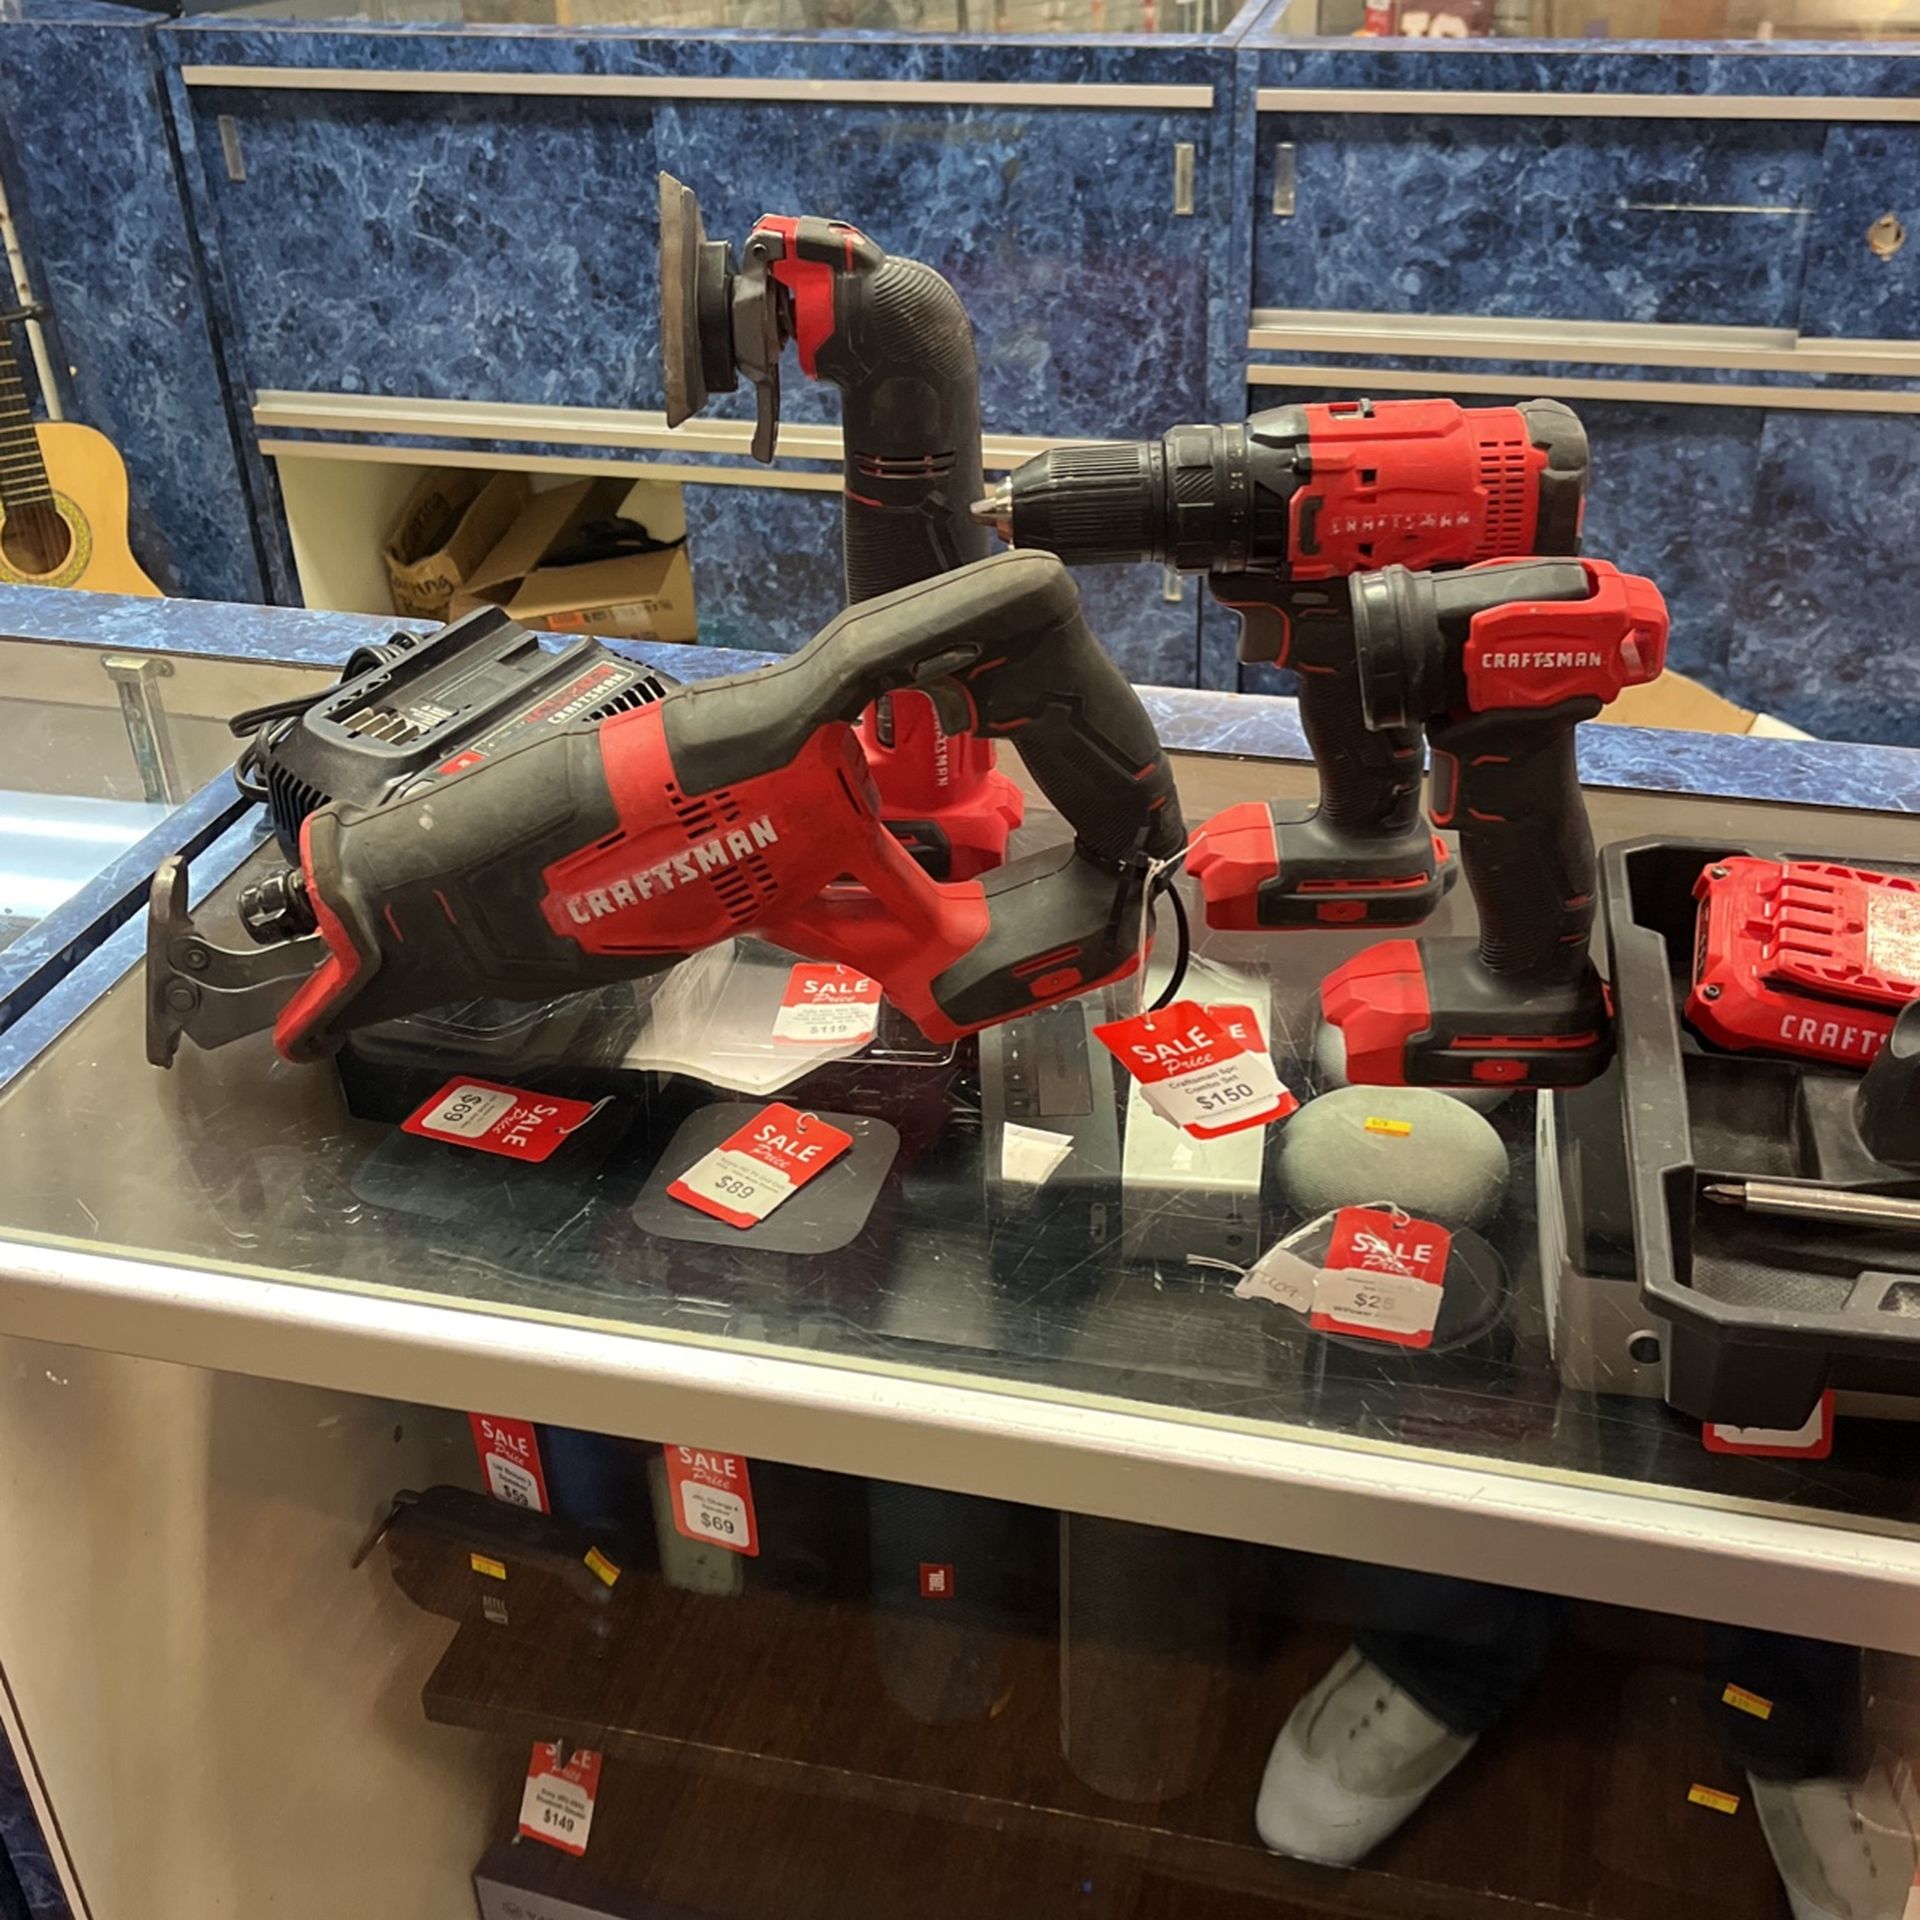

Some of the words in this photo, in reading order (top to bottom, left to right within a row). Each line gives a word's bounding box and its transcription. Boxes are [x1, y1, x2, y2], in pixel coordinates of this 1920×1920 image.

[1481, 651, 1602, 669] CRAFTSMAN
[546, 672, 627, 725] CRAFTSMAN
[566, 815, 779, 926] CRAFTSMAN
[803, 977, 870, 994] SALE
[810, 1024, 848, 1035] $119
[1780, 1014, 1889, 1056] CRAFT
[1131, 1025, 1215, 1064] SALE
[1162, 1052, 1215, 1076] Price
[443, 1093, 483, 1123] $69
[1196, 1082, 1254, 1111] $150
[492, 1106, 528, 1135] Price
[502, 1104, 559, 1148] SALE
[748, 1143, 791, 1169] Price
[753, 1123, 824, 1164] SALE
[714, 1174, 756, 1200] $89
[480, 1419, 531, 1458] SALE
[495, 1441, 526, 1466] Price
[678, 1445, 738, 1479] SALE
[691, 1467, 730, 1490] Price
[502, 1483, 529, 1507] $59
[700, 1511, 735, 1536] $69
[928, 1569, 946, 1592] JBL
[545, 1743, 593, 1769] SLE
[543, 1809, 575, 1834] $149
